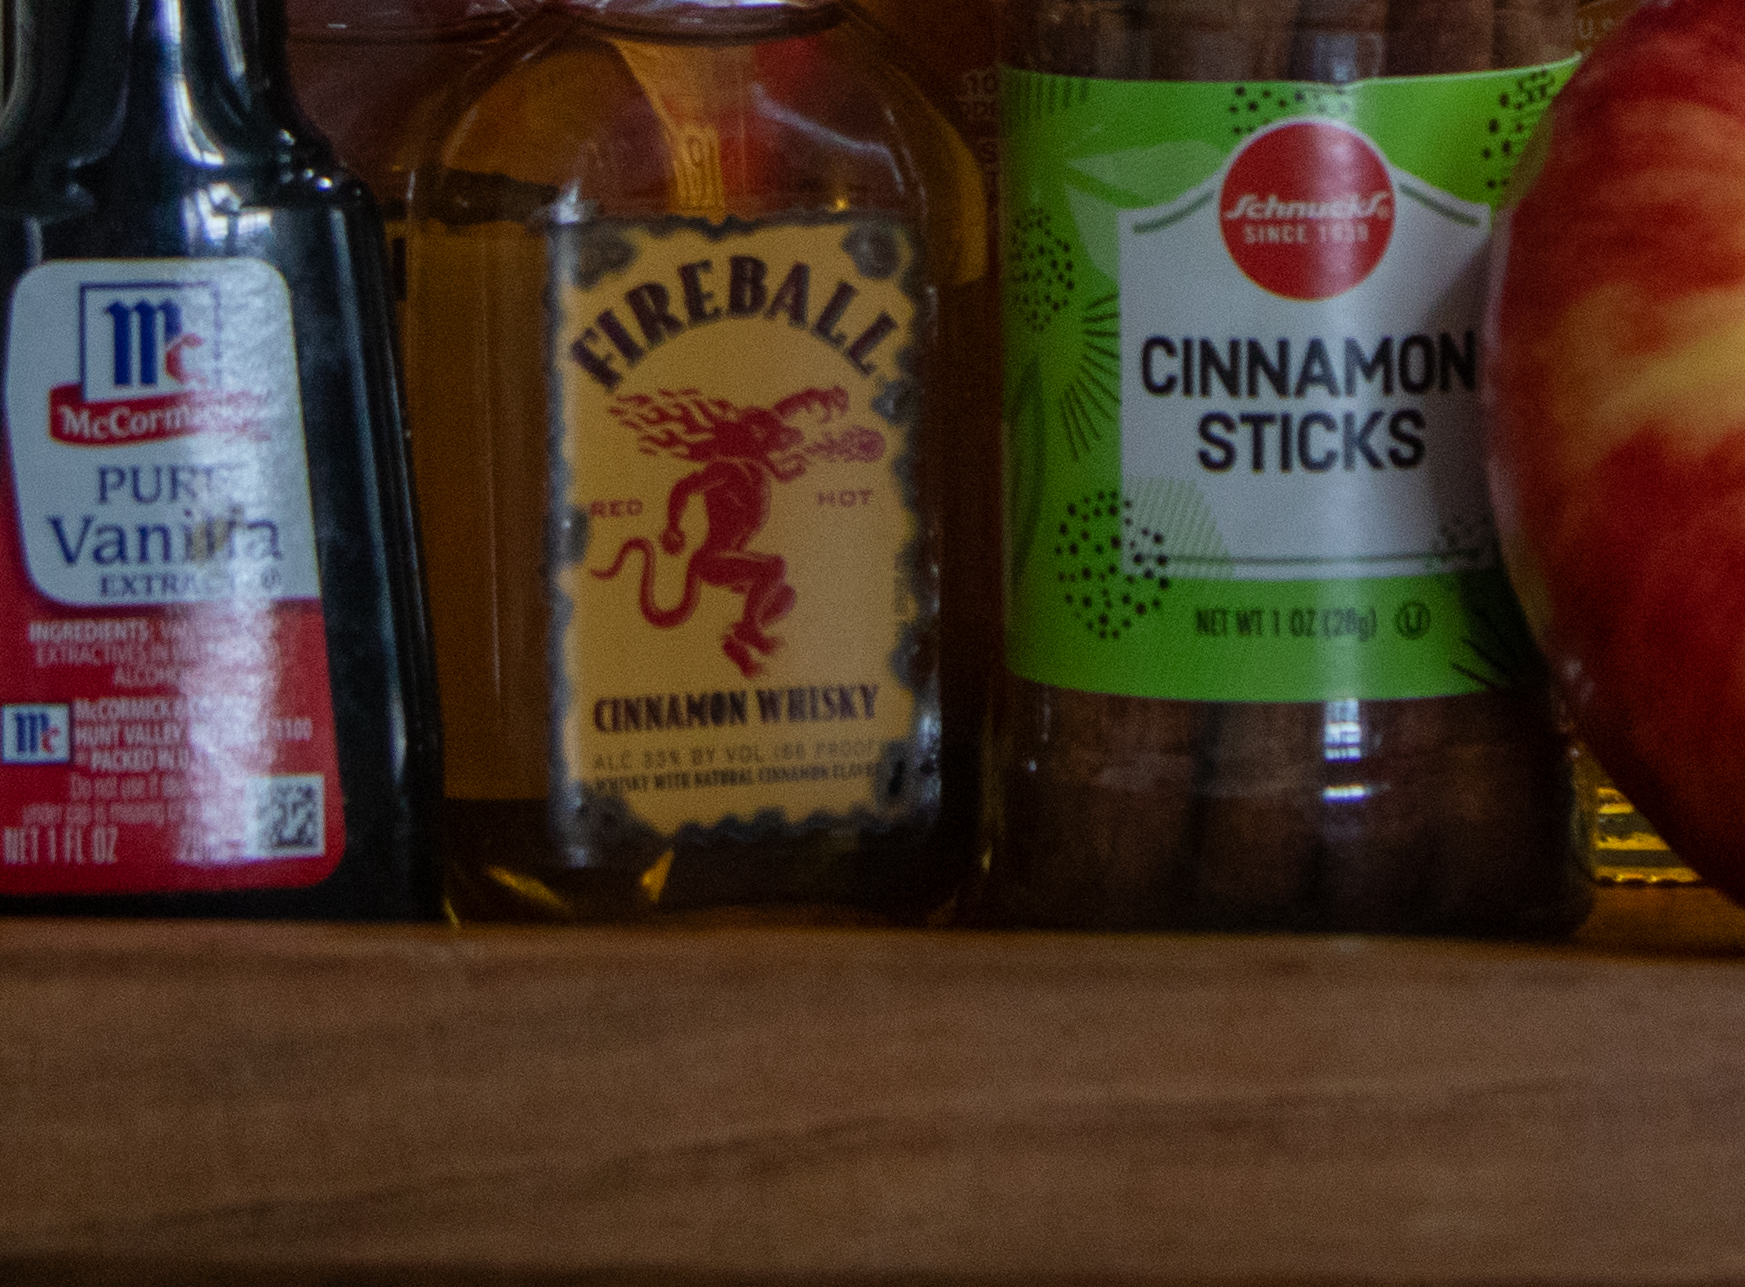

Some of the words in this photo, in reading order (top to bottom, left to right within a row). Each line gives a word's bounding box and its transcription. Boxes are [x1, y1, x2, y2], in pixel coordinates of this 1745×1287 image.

[1242, 223, 1310, 245] SINCE
[570, 255, 899, 393] FIREBALL
[1140, 332, 1477, 399] CINNAMON
[58, 400, 270, 440] McCorm
[1195, 409, 1427, 474] STICKS
[590, 498, 643, 518] RED
[817, 489, 873, 508] HOT
[99, 573, 236, 596] EXTRA
[1195, 608, 1233, 638] NET
[1235, 608, 1263, 637] WT
[1287, 607, 1318, 637] OZ
[593, 689, 748, 733] CINNAMON
[756, 683, 880, 725] WHISKY
[726, 744, 764, 764] VOL
[2, 827, 40, 864] NET
[47, 827, 57, 863] 1
[63, 827, 85, 863] FL
[92, 827, 119, 863] OZ
